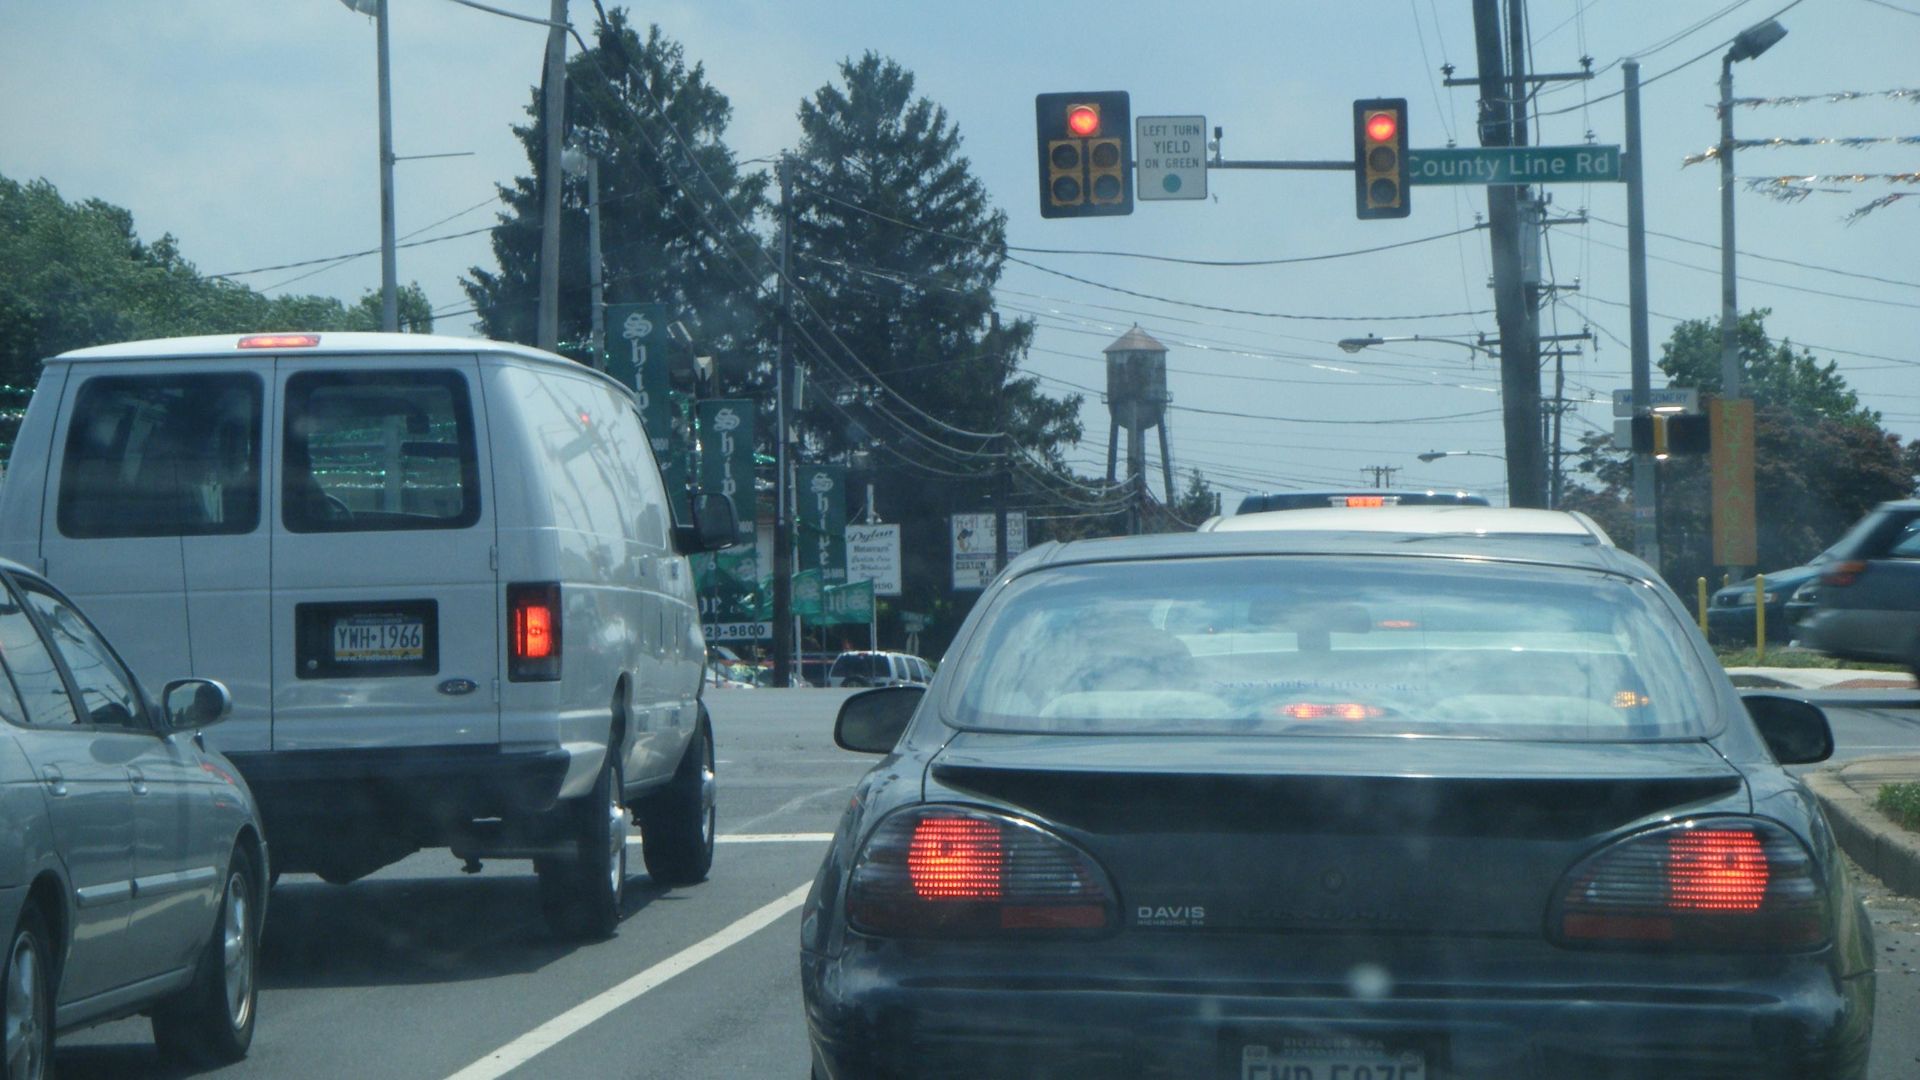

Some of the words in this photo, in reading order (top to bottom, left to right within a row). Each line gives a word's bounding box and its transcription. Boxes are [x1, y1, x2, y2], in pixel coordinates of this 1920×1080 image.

[1143, 125, 1167, 137] LEFT
[1173, 124, 1200, 136] TURN
[1153, 140, 1191, 154] YIELD
[1144, 159, 1159, 169] ON
[1165, 158, 1200, 169] GREEN
[1409, 156, 1500, 180] County
[1509, 154, 1566, 175] Line
[1576, 152, 1610, 174] Rd
[1721, 400, 1744, 565] ENTRANCE
[1138, 906, 1205, 919] DAVIS
